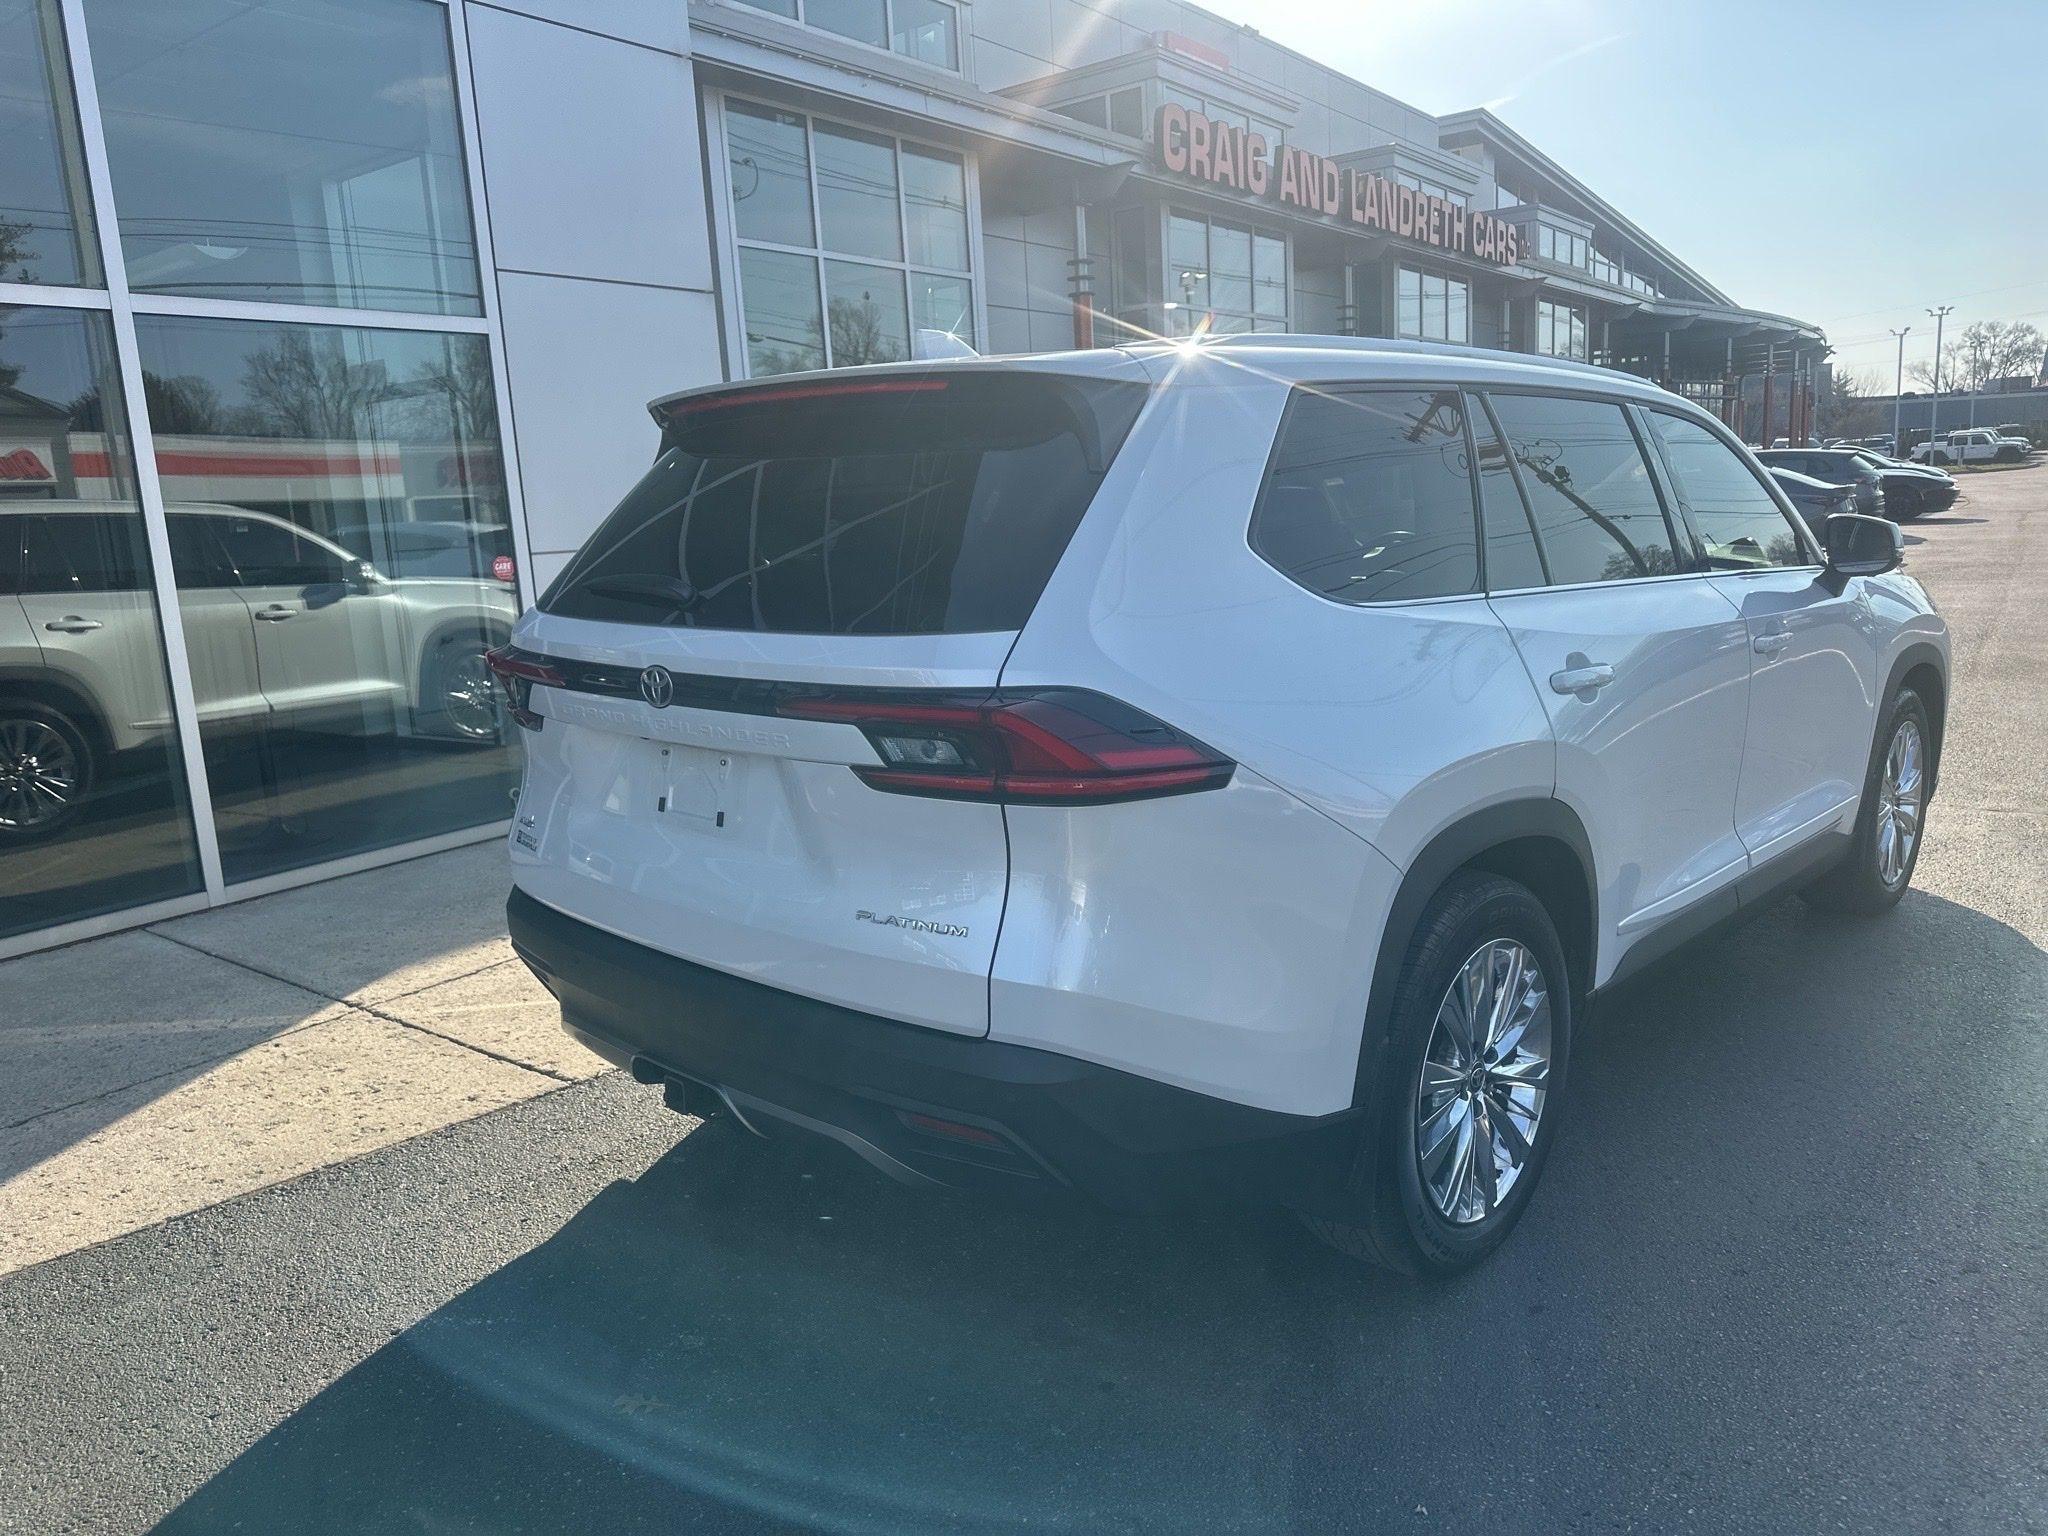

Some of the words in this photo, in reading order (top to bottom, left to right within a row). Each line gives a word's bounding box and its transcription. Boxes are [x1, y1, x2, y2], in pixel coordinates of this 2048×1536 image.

[1161, 102, 1267, 195] CRAIG
[1279, 146, 1339, 215] AND
[1350, 169, 1466, 251] LANDRETH
[1473, 211, 1517, 266] CARS
[633, 714, 791, 748] HIGHLANDER
[855, 909, 969, 938] PLATINUM
